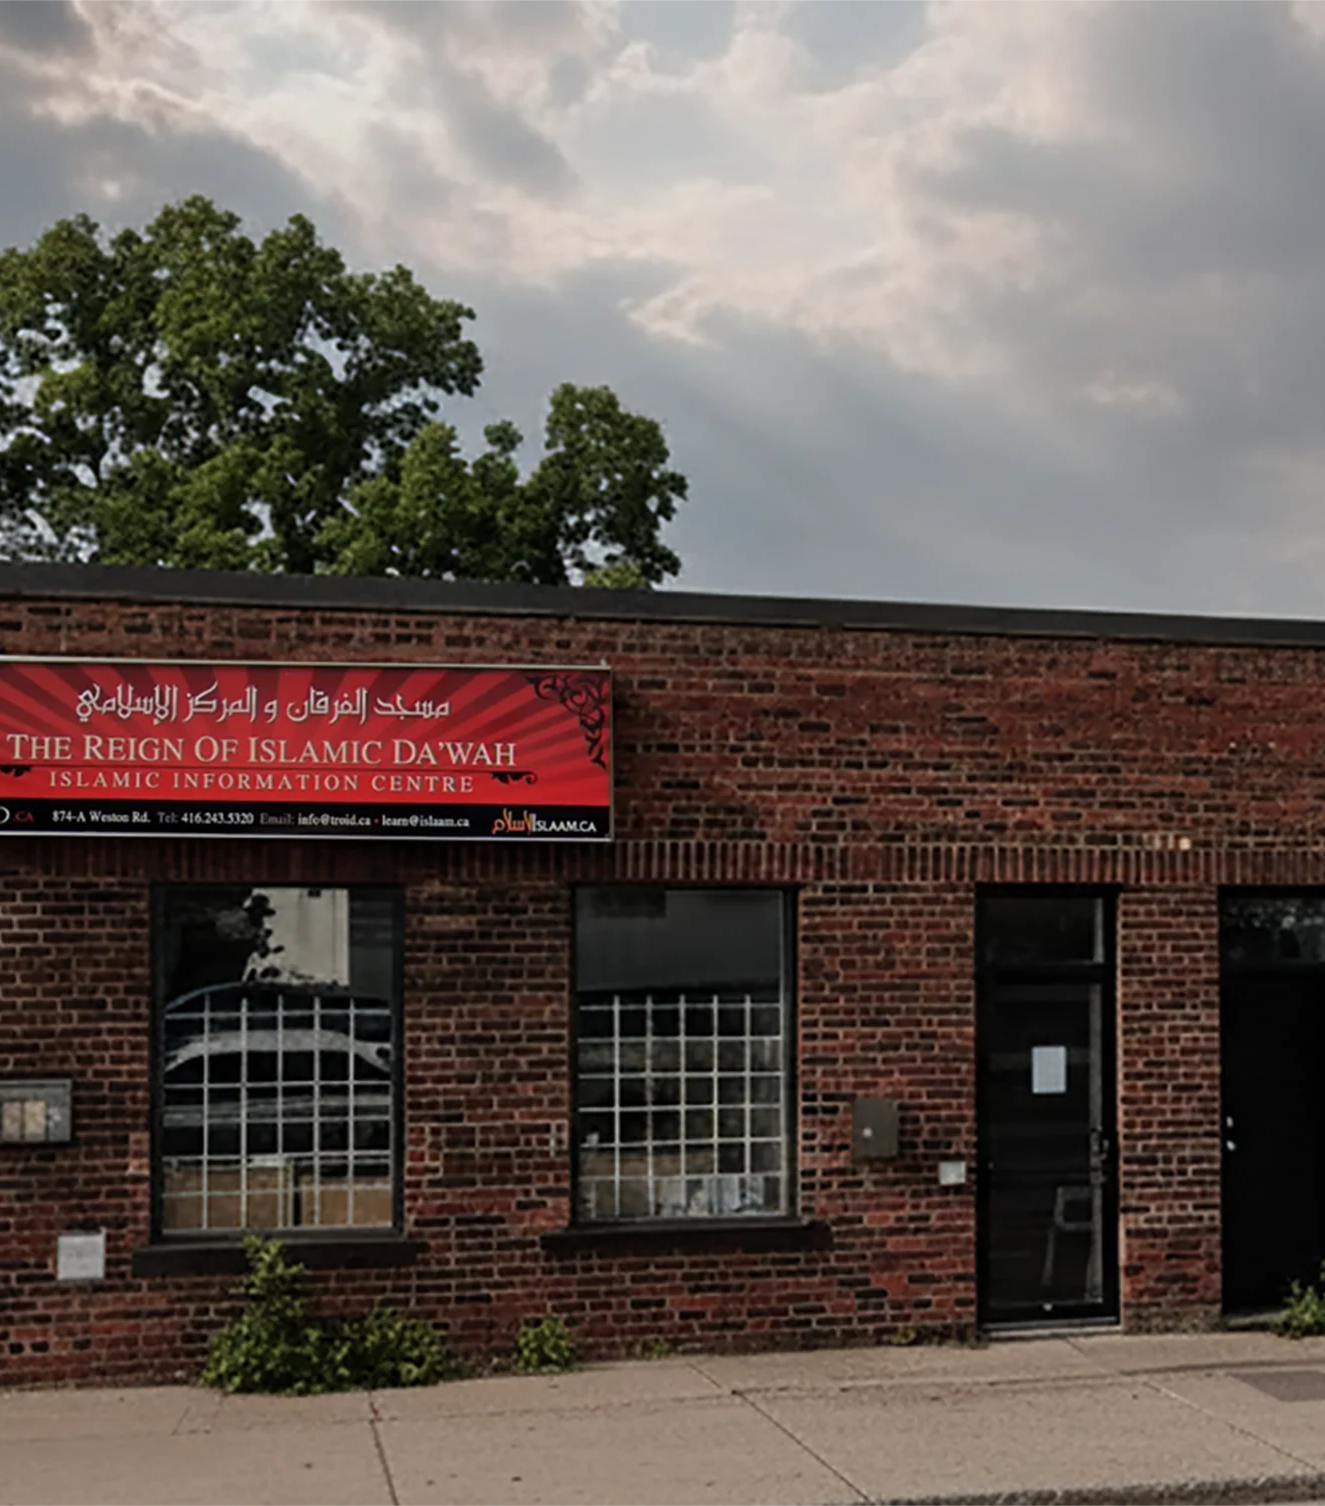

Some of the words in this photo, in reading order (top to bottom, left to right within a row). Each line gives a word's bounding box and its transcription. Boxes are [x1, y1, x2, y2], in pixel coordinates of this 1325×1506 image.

[182, 681, 258, 724] المركز
[263, 699, 278, 724] و
[286, 685, 369, 725] الفرقان
[373, 692, 450, 721] مسجد
[5, 733, 73, 761] THE
[82, 734, 184, 763] REIGN
[194, 736, 239, 763] OF
[248, 736, 383, 766] ISLAMIC
[392, 738, 517, 767] DA'WAH
[49, 771, 160, 789] ISLAMIC
[173, 772, 359, 792] INFORMATION
[371, 775, 474, 793] CENTRE
[52, 810, 87, 823] 874-A
[89, 810, 130, 823] Weston
[132, 810, 152, 824] Rd.
[181, 811, 255, 825] 416.243.5320
[297, 813, 372, 827] info@troid.ca
[381, 814, 471, 828] learn@islaam.ca
